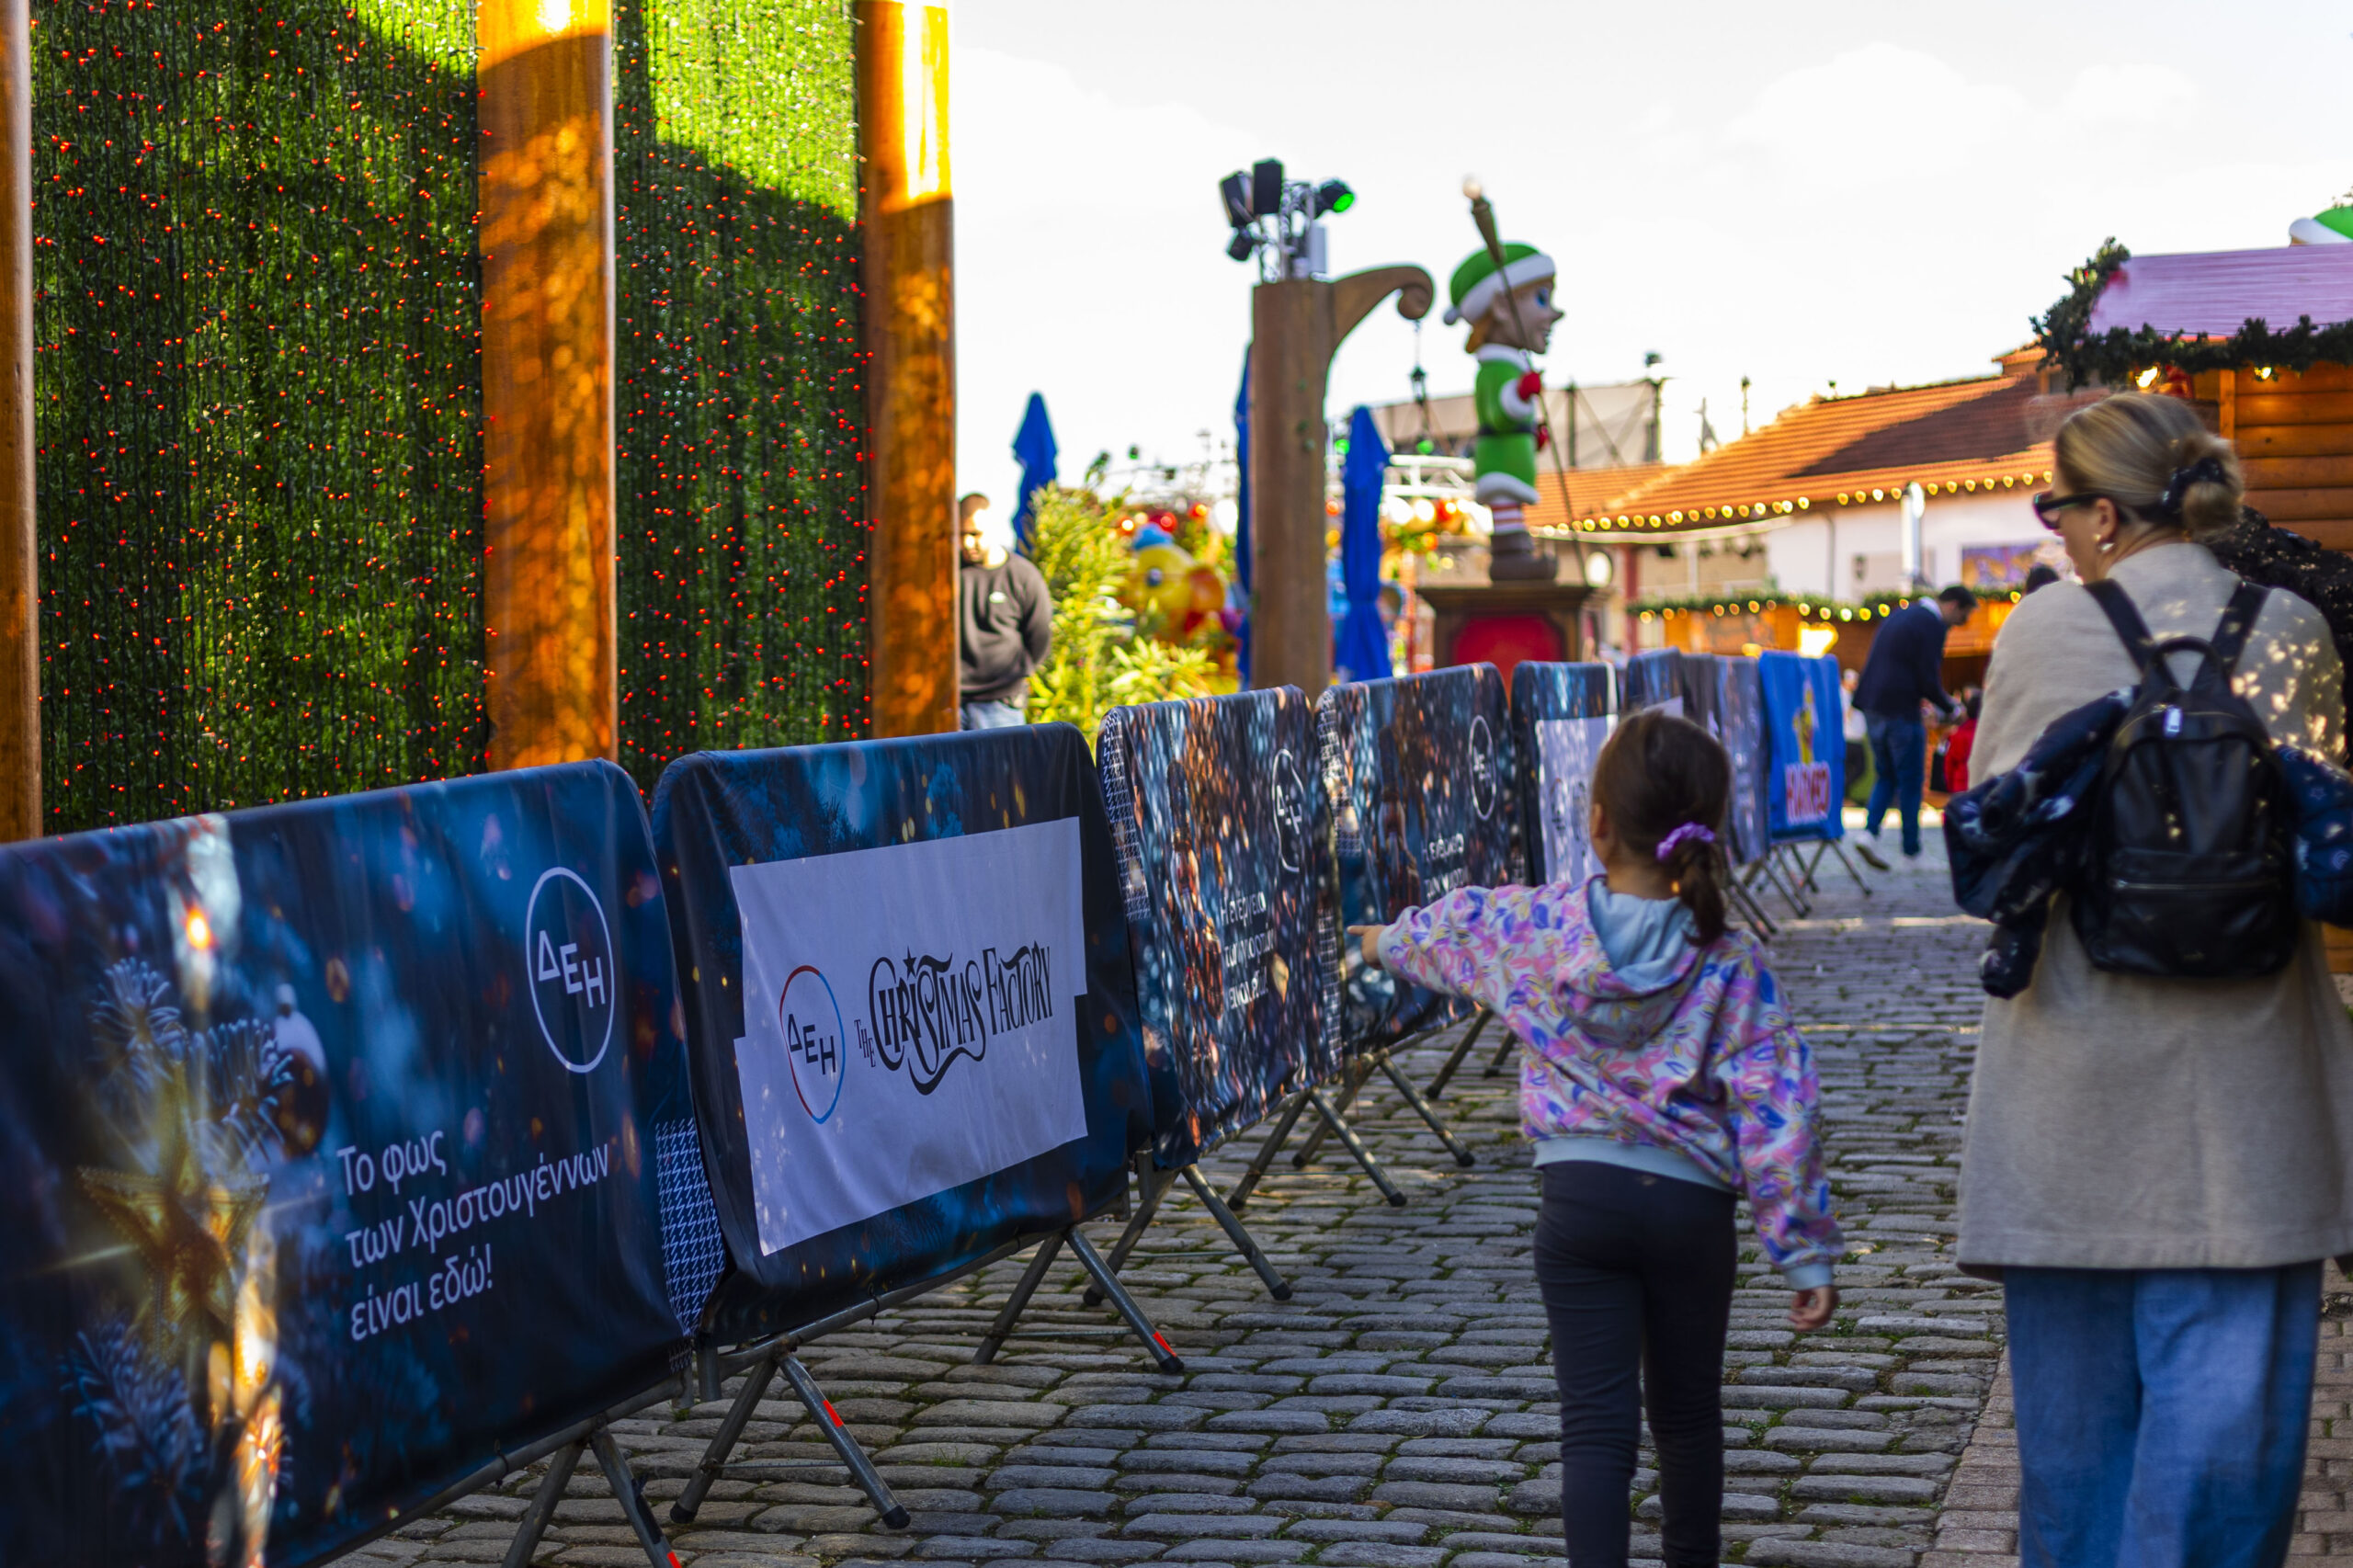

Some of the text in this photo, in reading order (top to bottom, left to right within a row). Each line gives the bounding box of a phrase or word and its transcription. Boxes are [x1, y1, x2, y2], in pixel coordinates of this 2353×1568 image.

[538, 930, 606, 1008] ΔΕΗ
[787, 1013, 836, 1075] ΔΕΗ
[853, 940, 1053, 1096] THE CHRISTMAS FACTORY
[336, 1131, 447, 1196] Το φως
[345, 1143, 608, 1268] των Χριστουγέννων
[350, 1244, 493, 1341] είναι εδώ!
